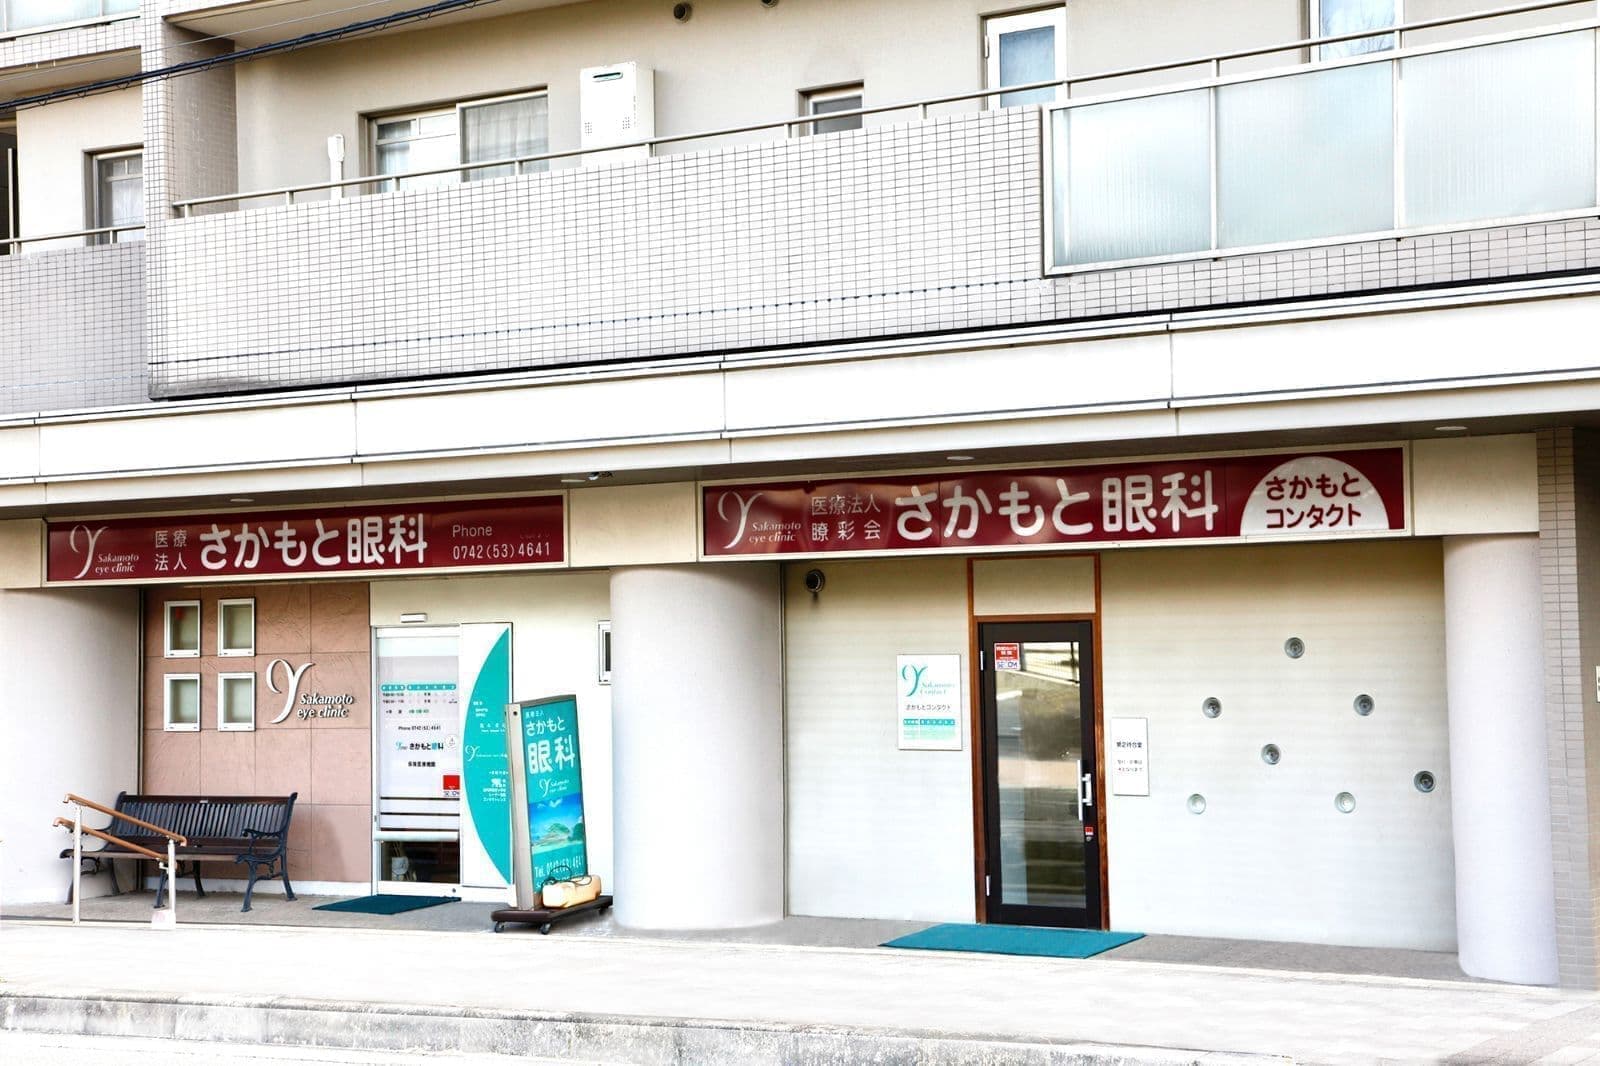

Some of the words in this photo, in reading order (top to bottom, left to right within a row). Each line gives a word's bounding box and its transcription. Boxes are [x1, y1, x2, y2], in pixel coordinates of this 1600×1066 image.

[1265, 472, 1361, 501] さかもと
[811, 493, 881, 516] 医療法人
[895, 470, 1219, 540] さかもと眼科
[1265, 503, 1361, 529] コンタクト
[452, 524, 493, 538] Phone
[752, 522, 802, 532] Sakamoto
[811, 519, 881, 542] 瞭彩会
[155, 529, 188, 548] 医療
[199, 513, 428, 570] さかもと眼科
[749, 534, 767, 544] eye
[769, 531, 797, 542] clinic
[97, 553, 139, 563] Sakamoto
[453, 542, 550, 560] 0742(53)4641
[95, 565, 110, 575] eye
[112, 562, 135, 573] clinic
[155, 552, 188, 571] 法人
[300, 692, 354, 705] Sakamoto
[297, 707, 316, 720] eye
[318, 704, 349, 718] clinic
[525, 716, 566, 737] さかもと
[527, 734, 576, 775] 眼科
